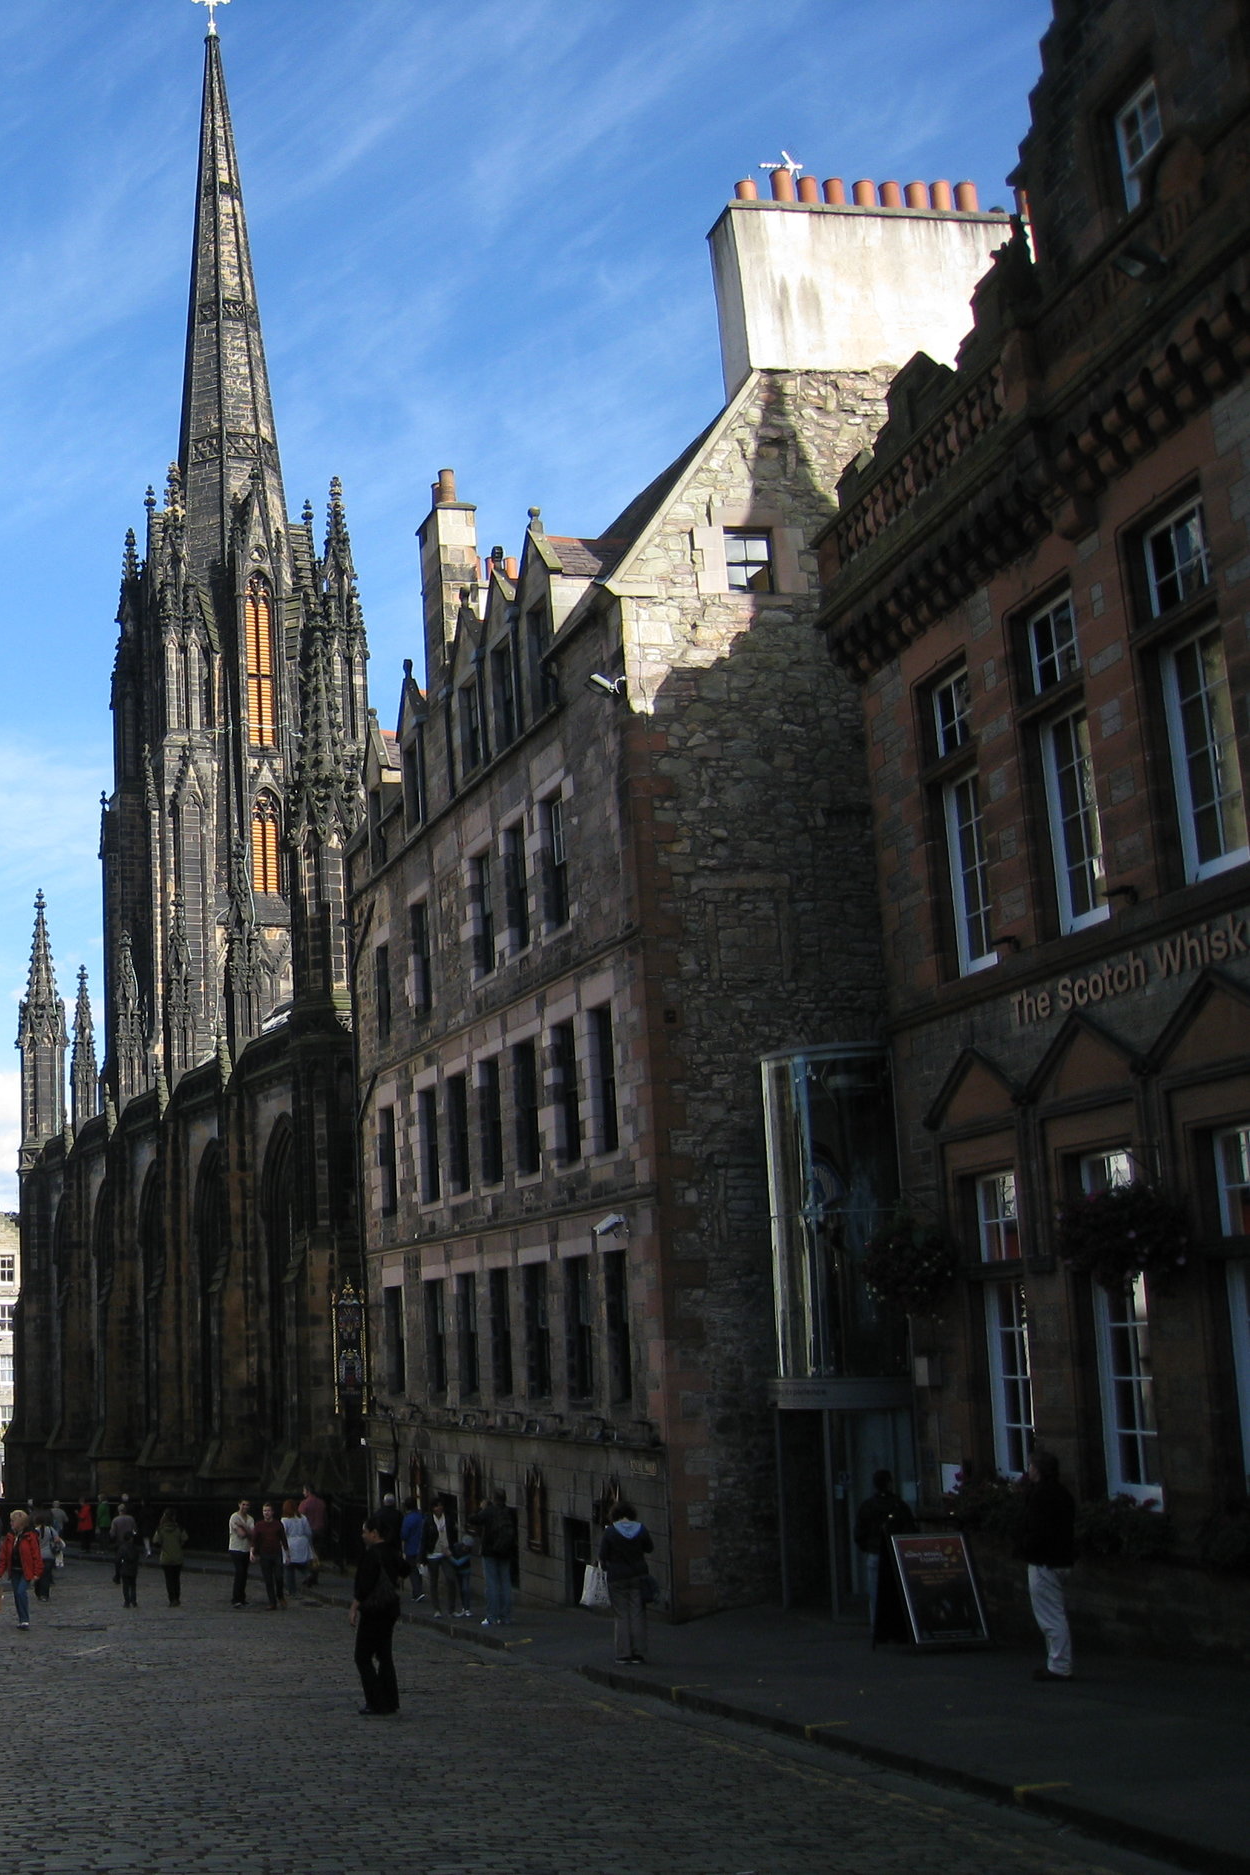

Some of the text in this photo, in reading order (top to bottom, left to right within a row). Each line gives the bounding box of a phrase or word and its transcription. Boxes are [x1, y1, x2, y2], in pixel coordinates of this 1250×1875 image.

[1010, 912, 1250, 1026] The Scotch Whisk
